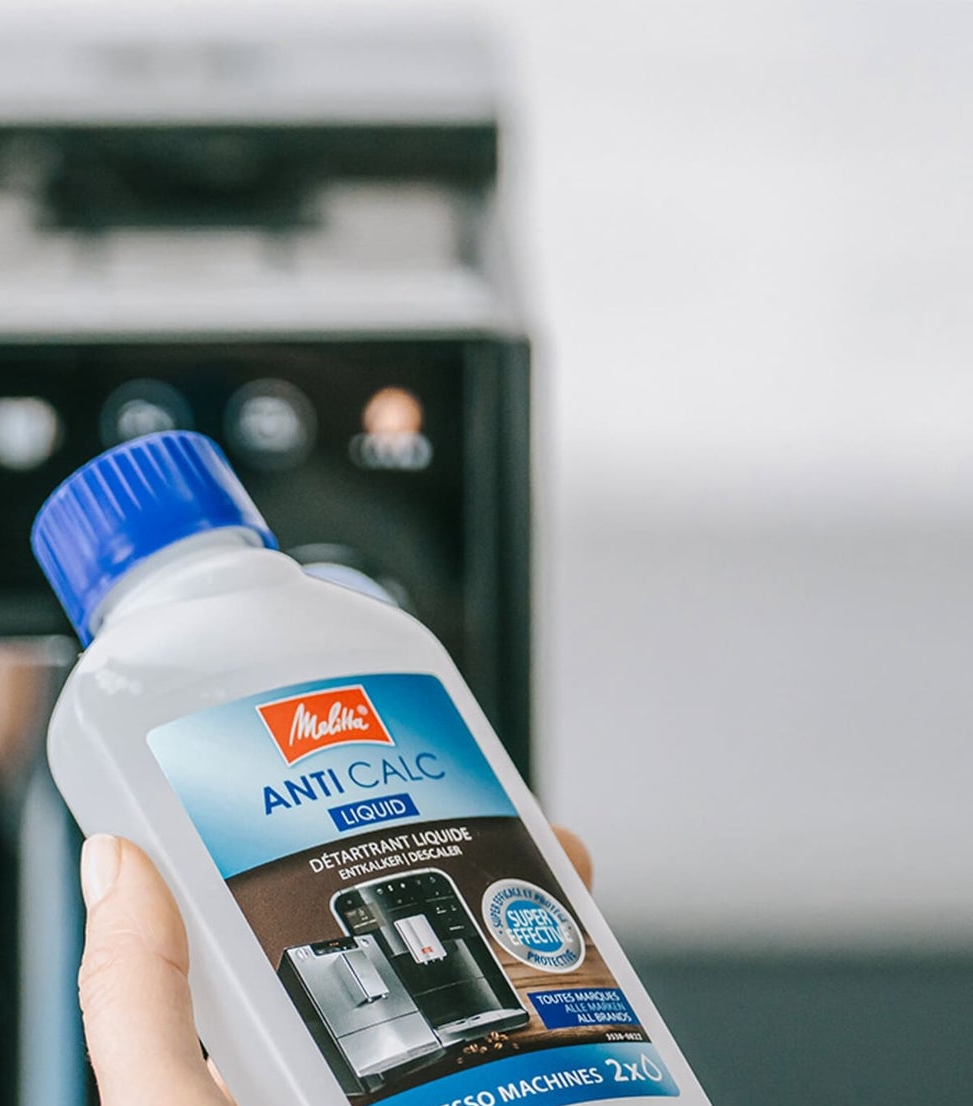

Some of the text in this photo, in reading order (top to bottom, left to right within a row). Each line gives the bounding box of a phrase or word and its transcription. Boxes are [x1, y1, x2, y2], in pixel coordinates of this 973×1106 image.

[288, 701, 370, 747] Melitta
[262, 752, 446, 816] ANTI CALC
[341, 799, 406, 825] LIQUID
[308, 827, 473, 873] DÉTARTRANT LIQUIDE
[507, 908, 553, 927] SUPER
[505, 926, 574, 946] EFFECTIVE
[536, 991, 621, 1005] TOUTES MARQUES
[565, 1001, 626, 1014] ALLE MARKEN
[577, 1012, 632, 1023] ALL BRANDS
[497, 1067, 604, 1102] MACHINES
